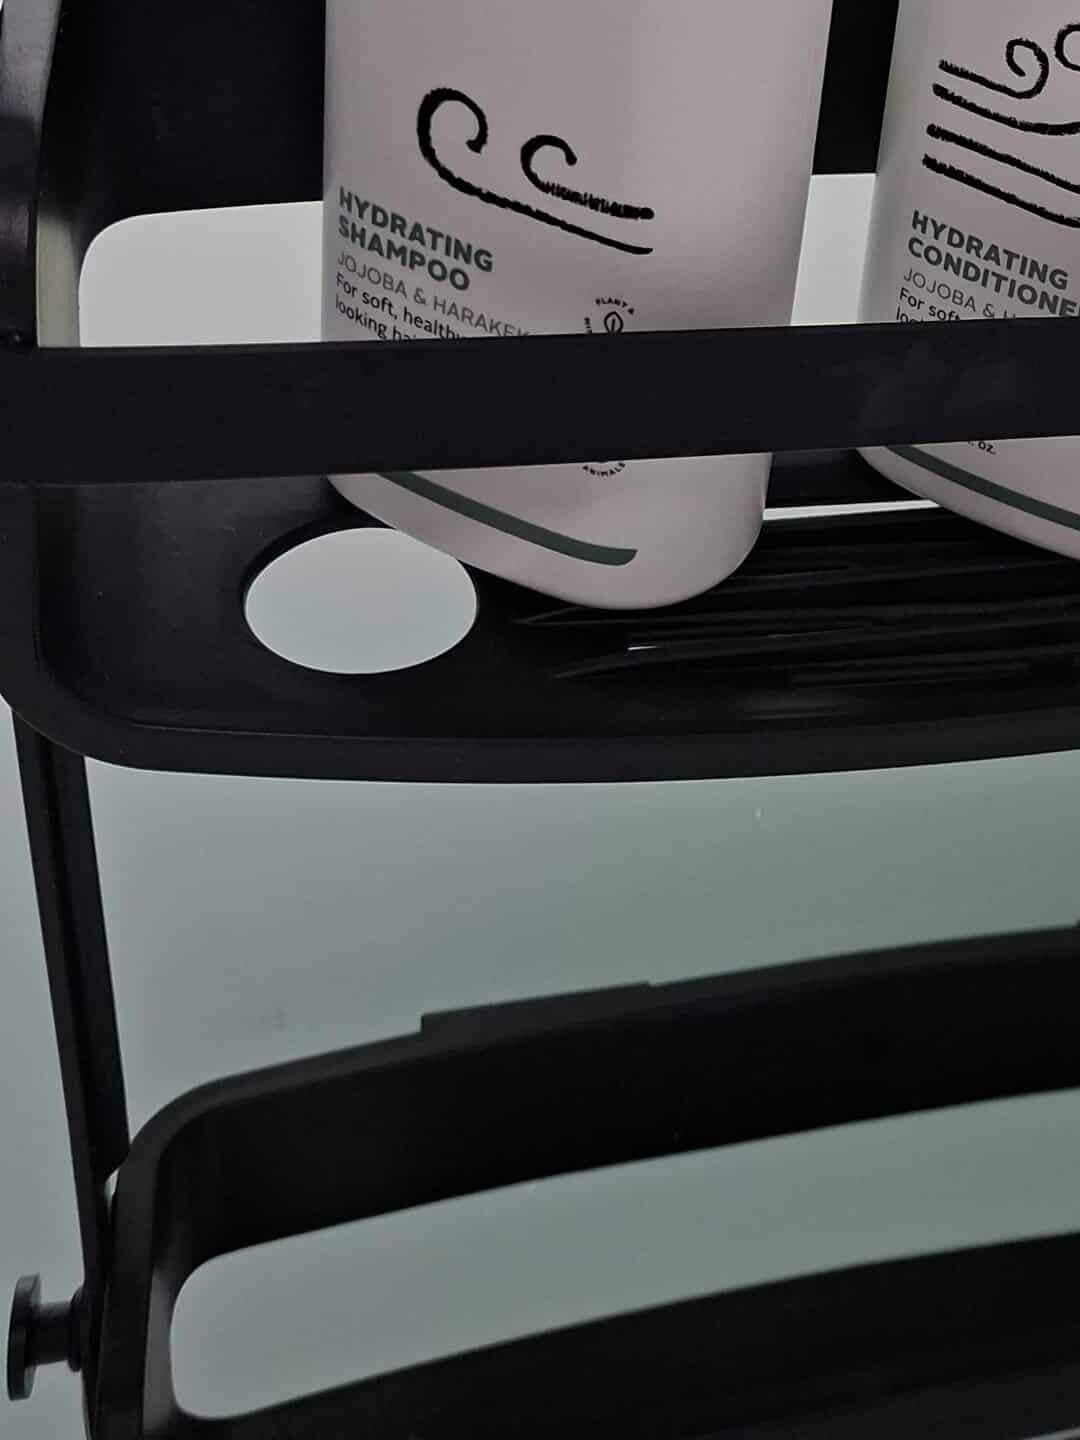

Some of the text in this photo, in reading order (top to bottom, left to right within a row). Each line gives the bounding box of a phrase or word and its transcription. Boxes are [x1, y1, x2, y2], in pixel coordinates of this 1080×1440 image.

[338, 214, 470, 291] SHAMPOO
[339, 185, 493, 272] HYDRATING
[912, 209, 1068, 290] HYDRATING
[336, 272, 358, 298] For
[362, 291, 398, 320] soft,
[338, 251, 407, 298] JOJOBA
[413, 287, 427, 306] &
[899, 287, 925, 310] For
[904, 267, 976, 313] JOJOBA
[335, 293, 388, 340] looking
